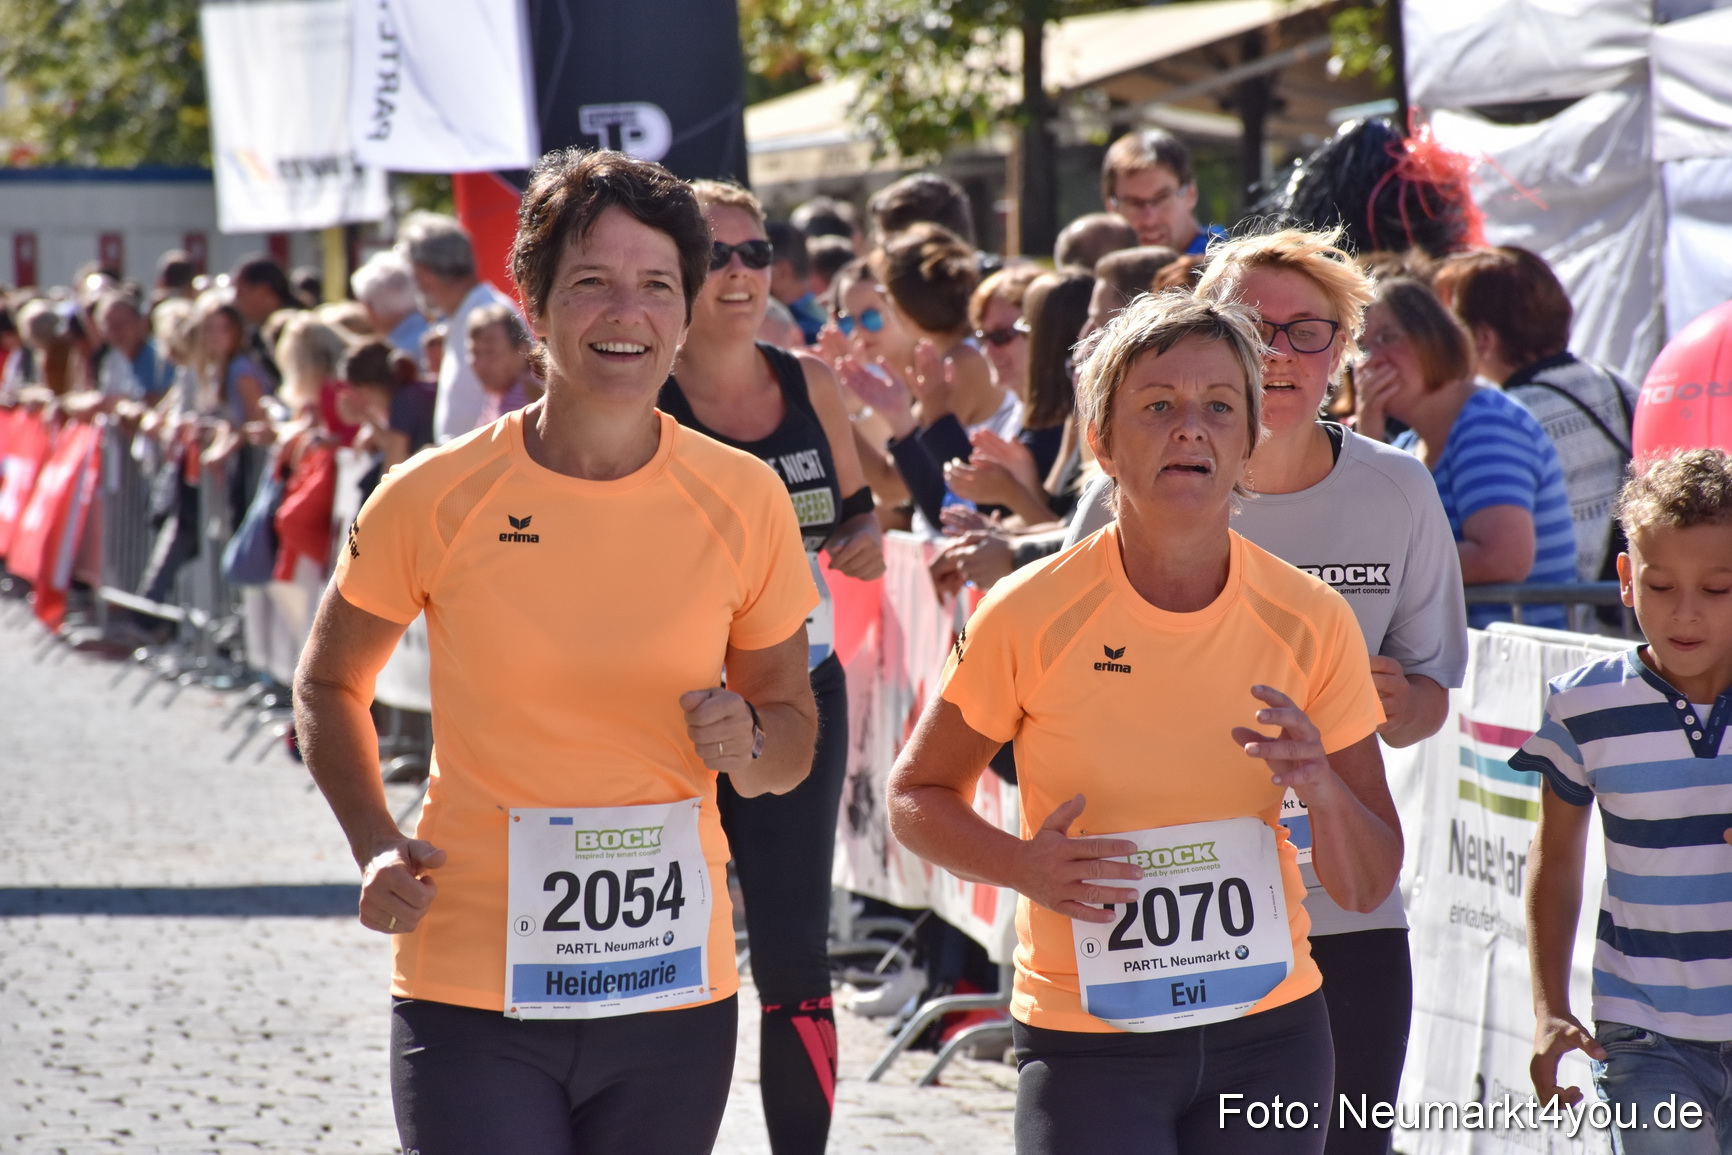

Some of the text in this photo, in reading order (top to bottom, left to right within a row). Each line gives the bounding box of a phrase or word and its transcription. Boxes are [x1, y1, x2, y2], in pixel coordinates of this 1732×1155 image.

[779, 449, 826, 485] NICHT
[792, 491, 833, 524] GEBEN
[498, 531, 540, 543] erima
[1362, 587, 1391, 596] concepts
[1093, 660, 1132, 674] erima
[575, 825, 664, 852] BOCK
[575, 852, 605, 861] inspired
[605, 851, 616, 860] by
[616, 849, 638, 859] smart
[1127, 841, 1220, 871] BOCK
[1143, 862, 1221, 878] ired by smart concepts
[542, 860, 686, 932] 2054
[519, 920, 529, 932] D
[1103, 877, 1255, 952] 2070
[556, 936, 660, 955] PARTL Neumarkt
[1086, 942, 1095, 954] D
[1123, 949, 1231, 973] PARTL Neumarkt
[546, 960, 677, 996] Heidemarie
[1170, 978, 1207, 1007] Evi
